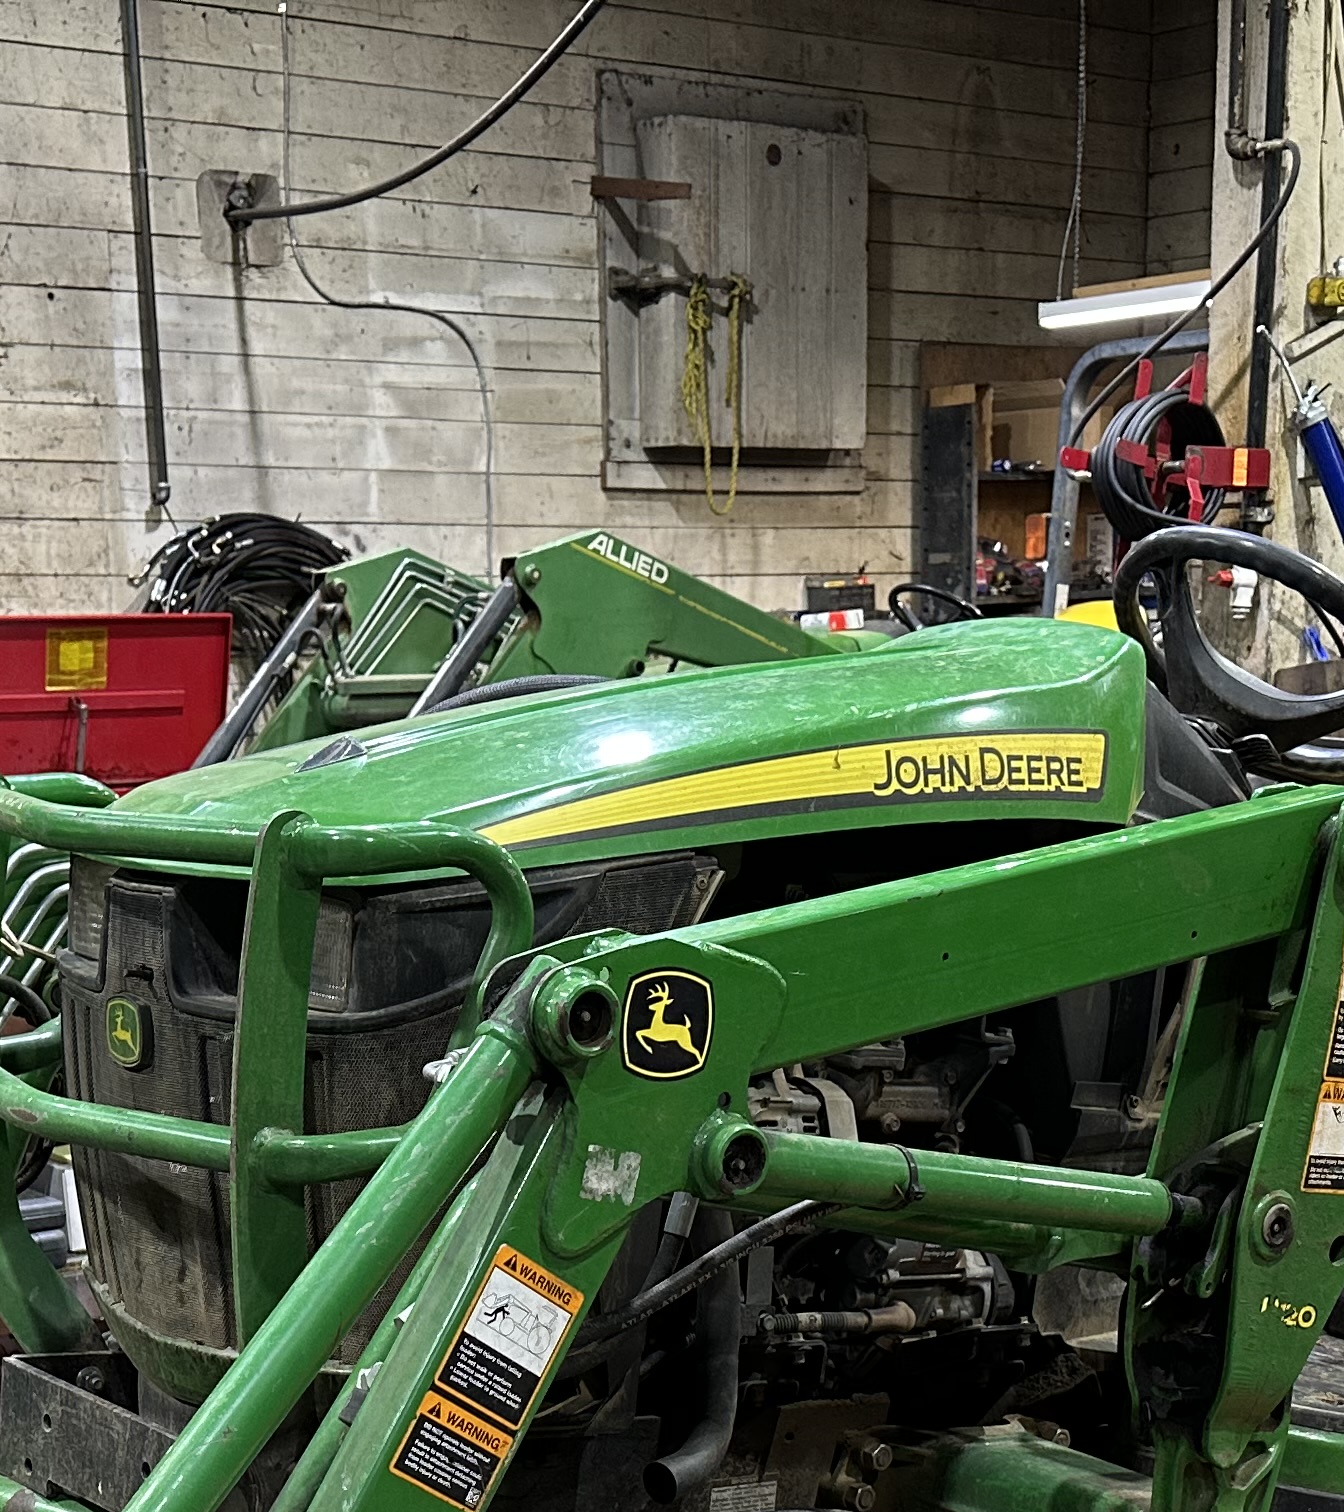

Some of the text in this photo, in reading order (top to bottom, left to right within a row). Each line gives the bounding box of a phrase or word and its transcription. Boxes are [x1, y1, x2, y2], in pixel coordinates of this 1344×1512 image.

[587, 533, 670, 584] ALLIED
[873, 746, 1084, 791] JOHN DEERE
[519, 1263, 573, 1306] WARNING
[445, 1411, 502, 1450] WARNING
